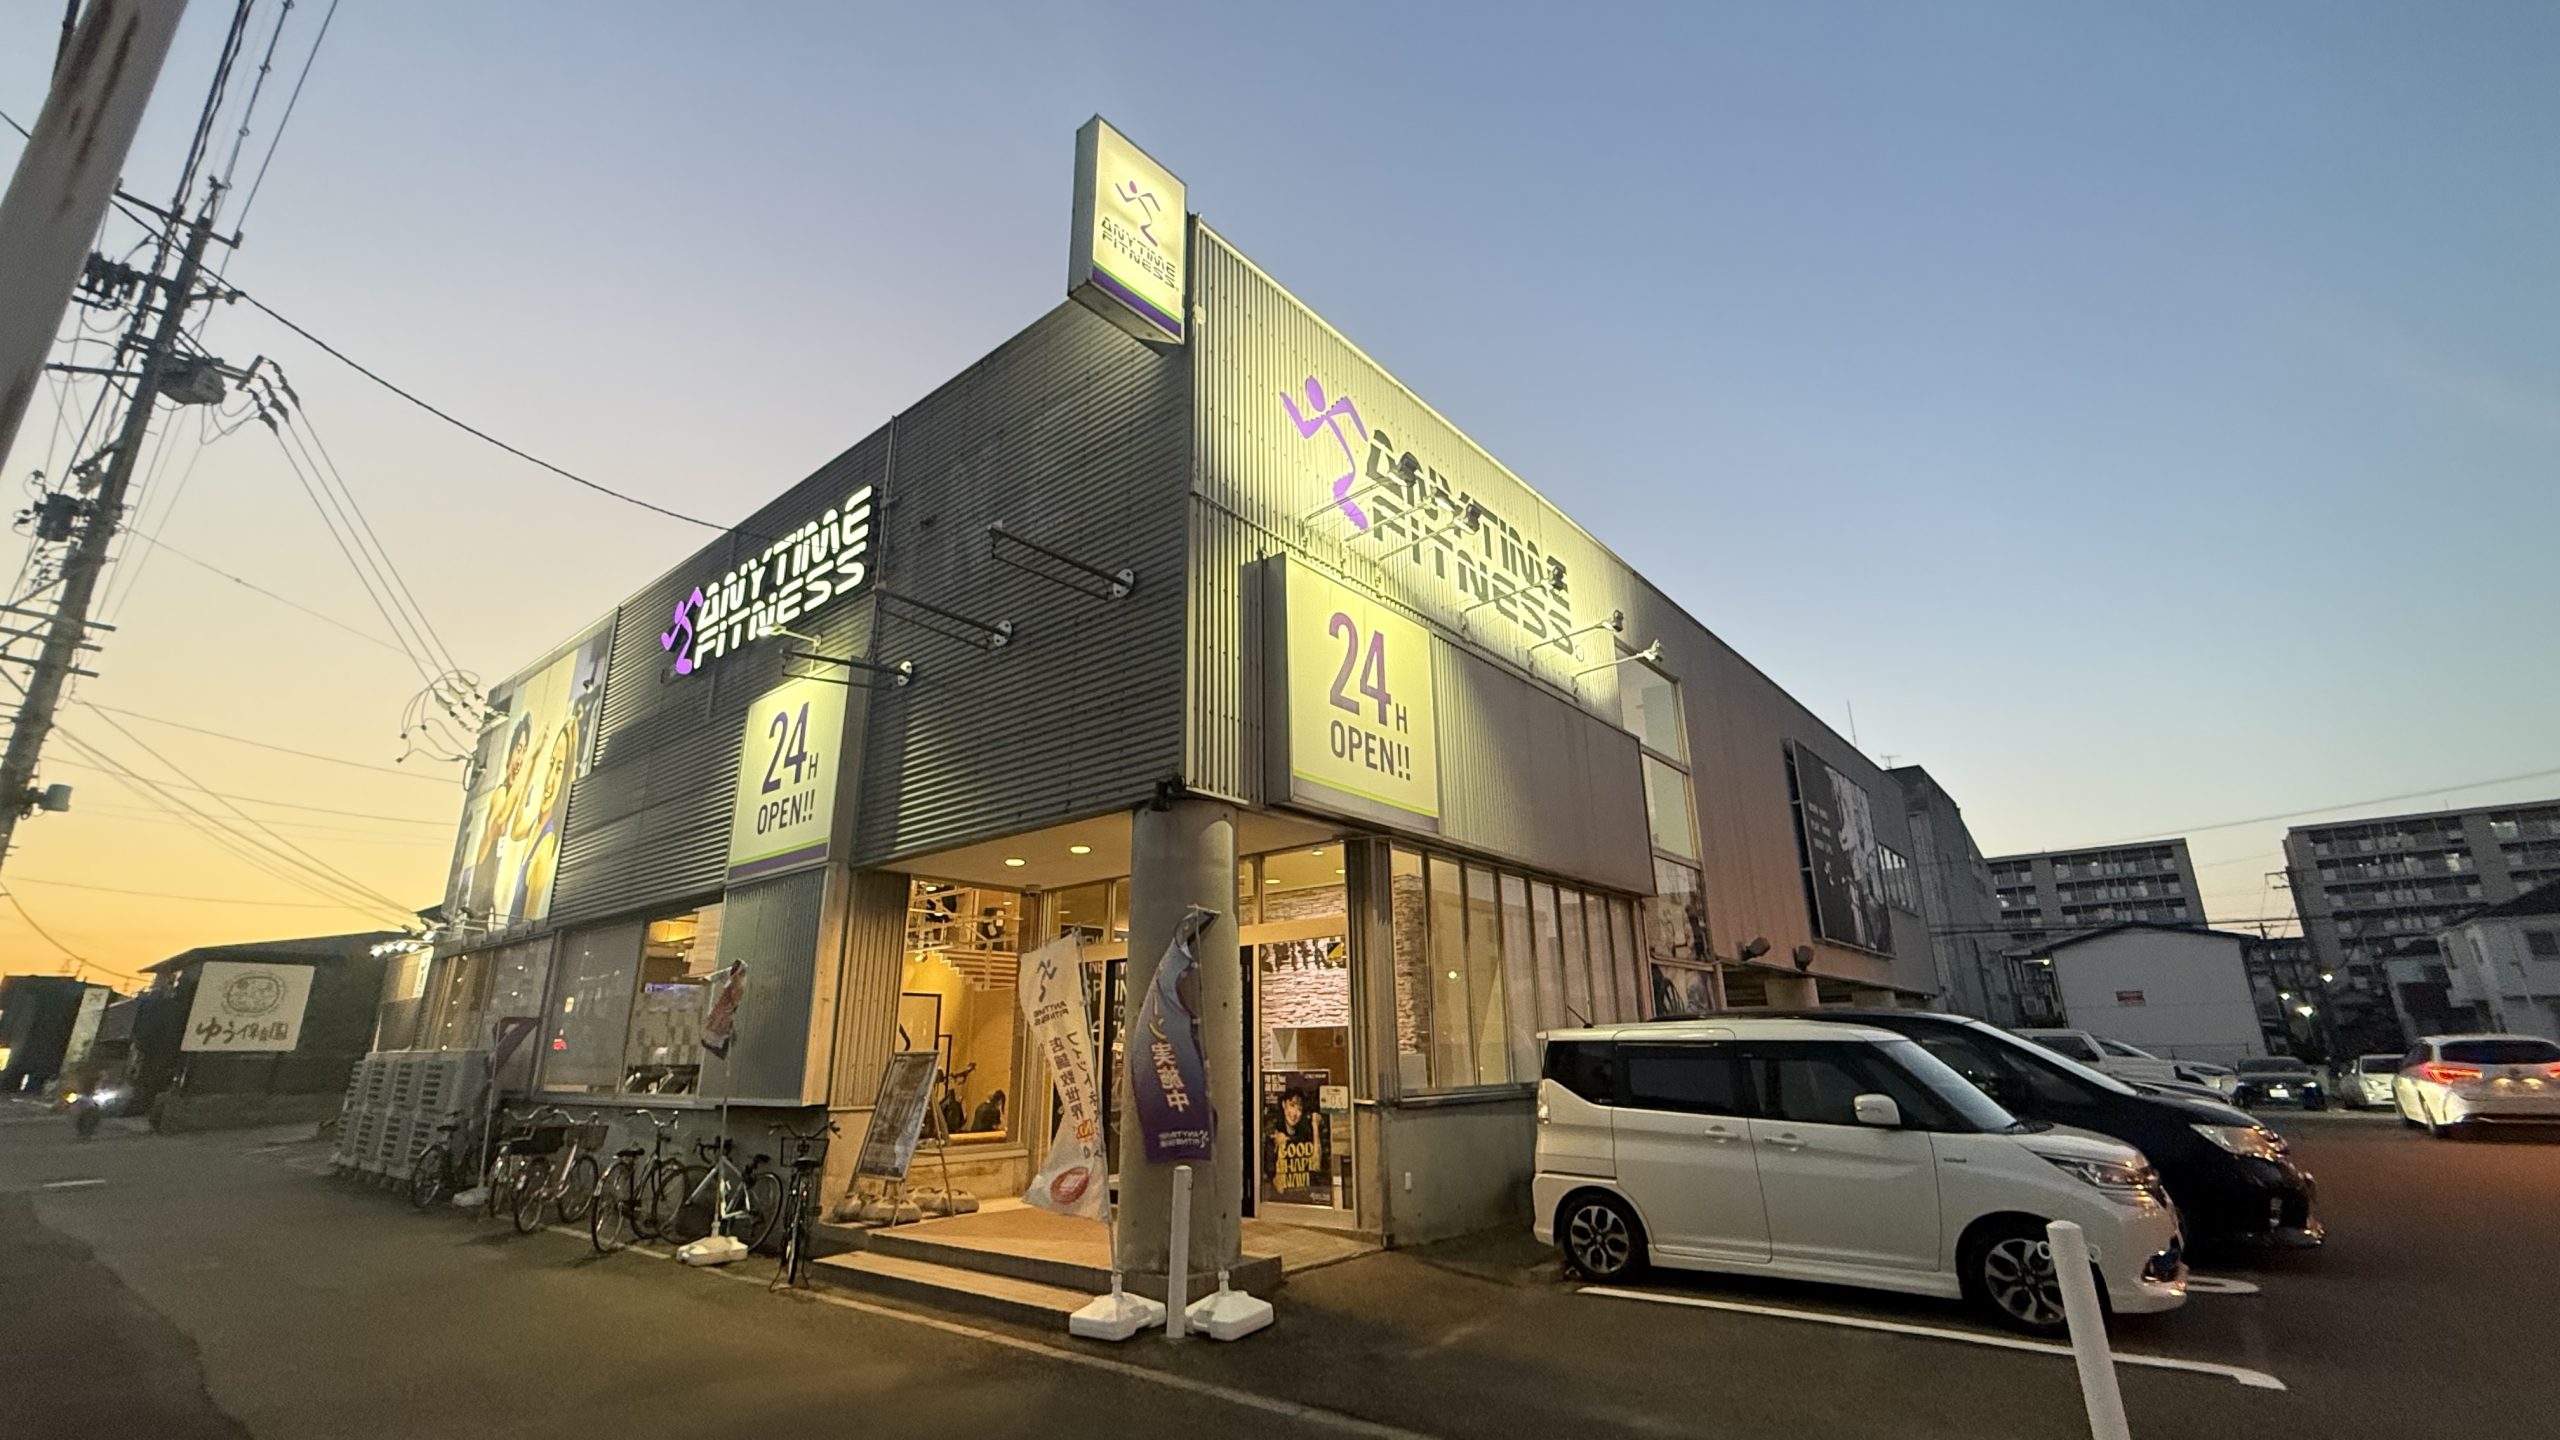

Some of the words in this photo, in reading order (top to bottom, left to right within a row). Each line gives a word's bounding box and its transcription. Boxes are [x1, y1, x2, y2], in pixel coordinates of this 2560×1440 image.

[1101, 217, 1176, 277] ANYTIME
[1102, 231, 1176, 289] FITNESS
[696, 485, 872, 632] ANYTIME
[1372, 495, 1574, 655] FITNESS
[693, 541, 867, 670] FITNESS
[1330, 720, 1411, 781] OPEN!!
[757, 789, 816, 836] OPEN!!
